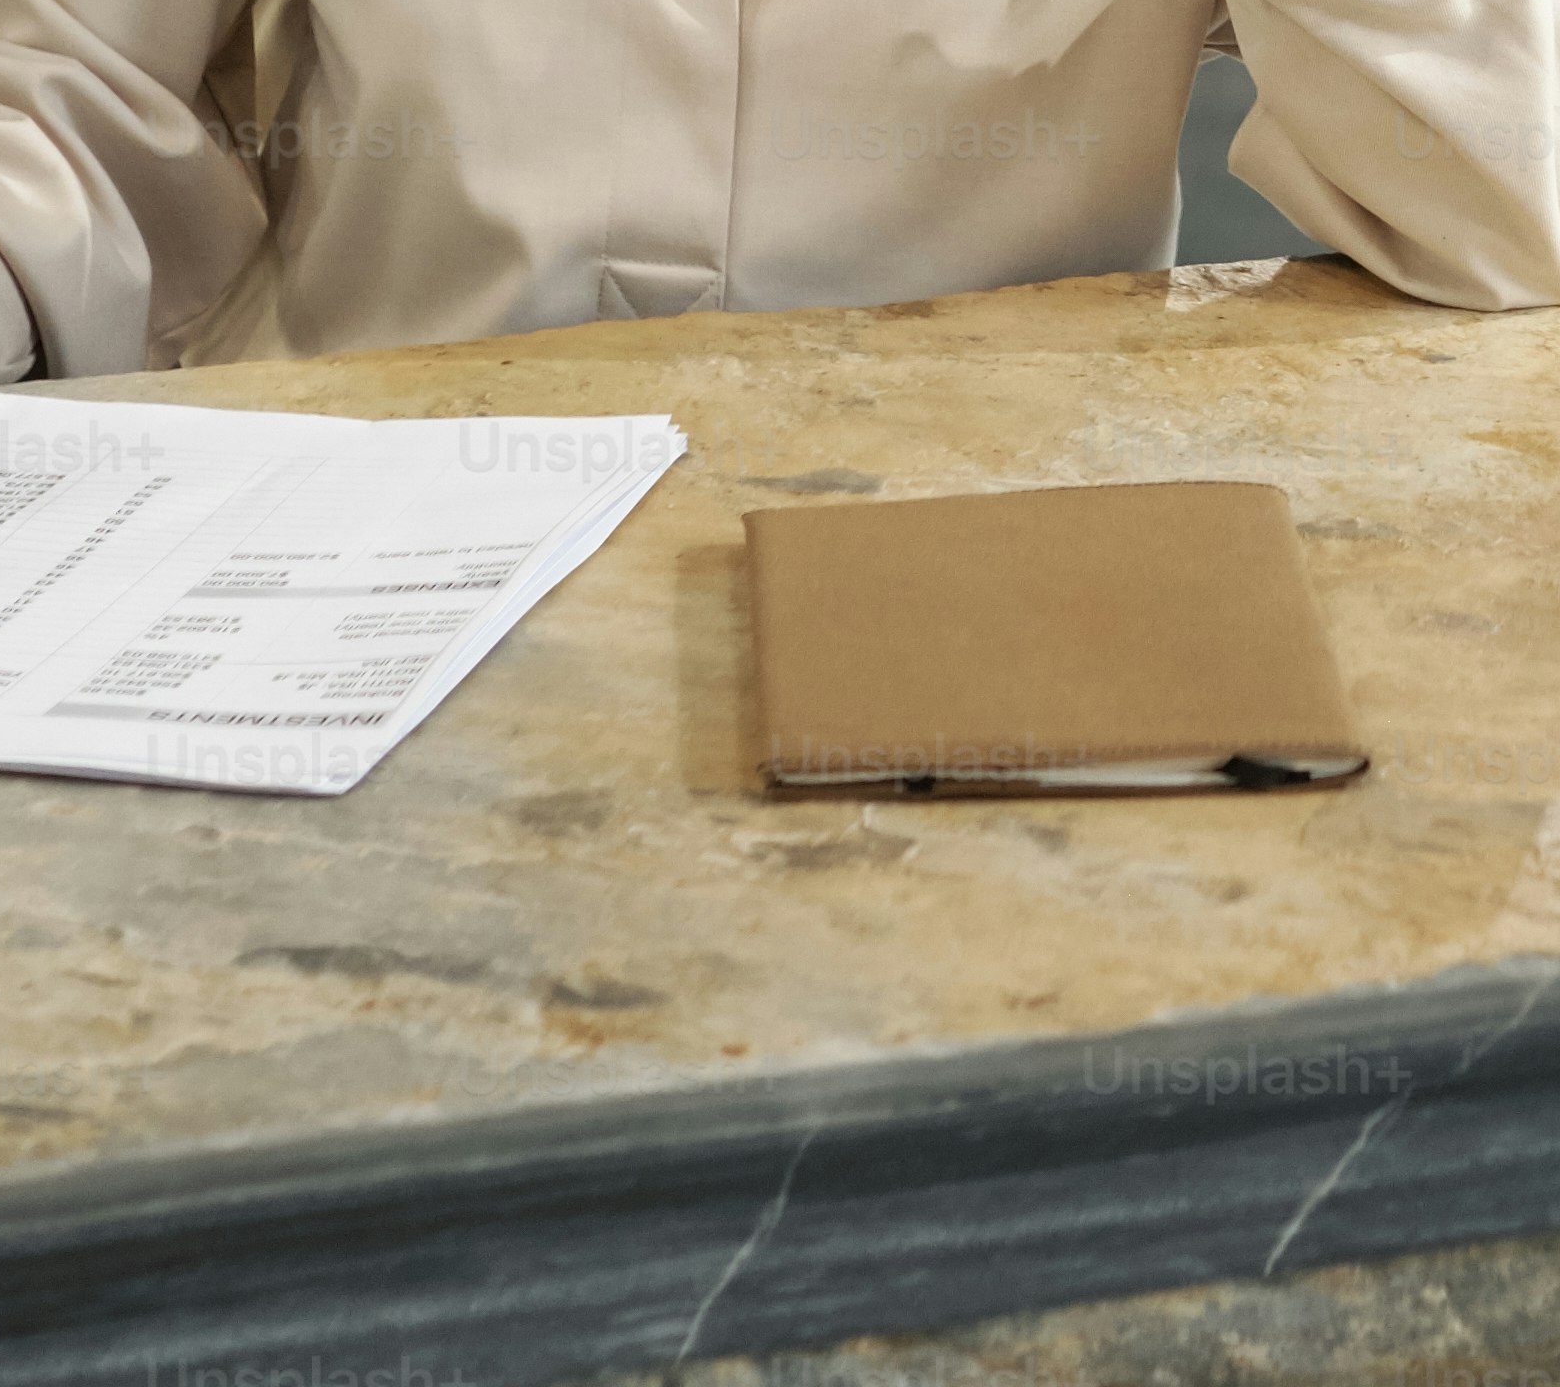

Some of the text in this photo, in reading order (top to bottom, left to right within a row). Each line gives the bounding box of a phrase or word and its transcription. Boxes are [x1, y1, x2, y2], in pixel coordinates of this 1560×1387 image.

[370, 578, 503, 594] EXPENSES
[320, 688, 406, 699] Brokerage
[147, 711, 386, 725] INVESTMENTS
